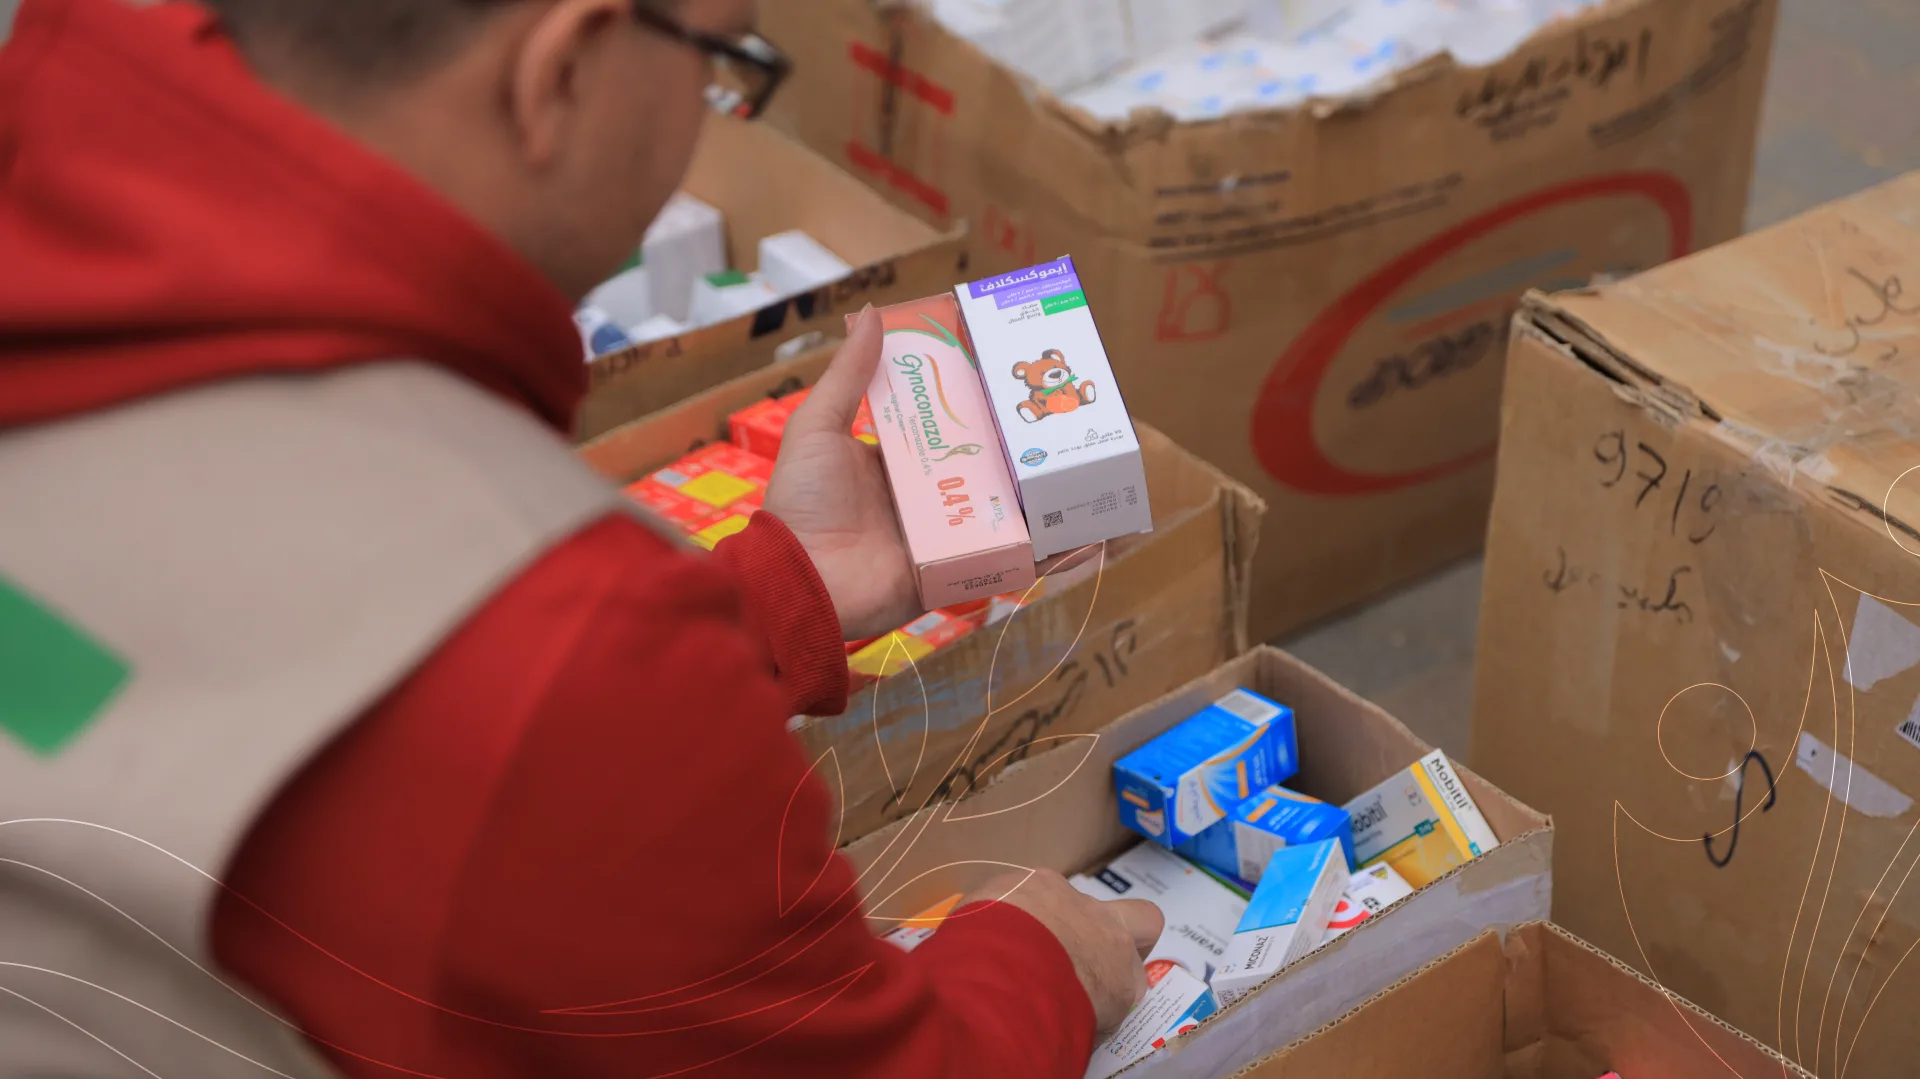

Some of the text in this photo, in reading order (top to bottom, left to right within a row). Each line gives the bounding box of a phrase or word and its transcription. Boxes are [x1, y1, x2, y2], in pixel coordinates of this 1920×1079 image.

[892, 353, 950, 450] Gynoconazol
[908, 415, 927, 457] Terconazole
[936, 476, 976, 527] 0.4%
[1431, 758, 1469, 808] Mobitil
[1179, 924, 1224, 956] evanic
[1245, 935, 1269, 970] MICONAZ
